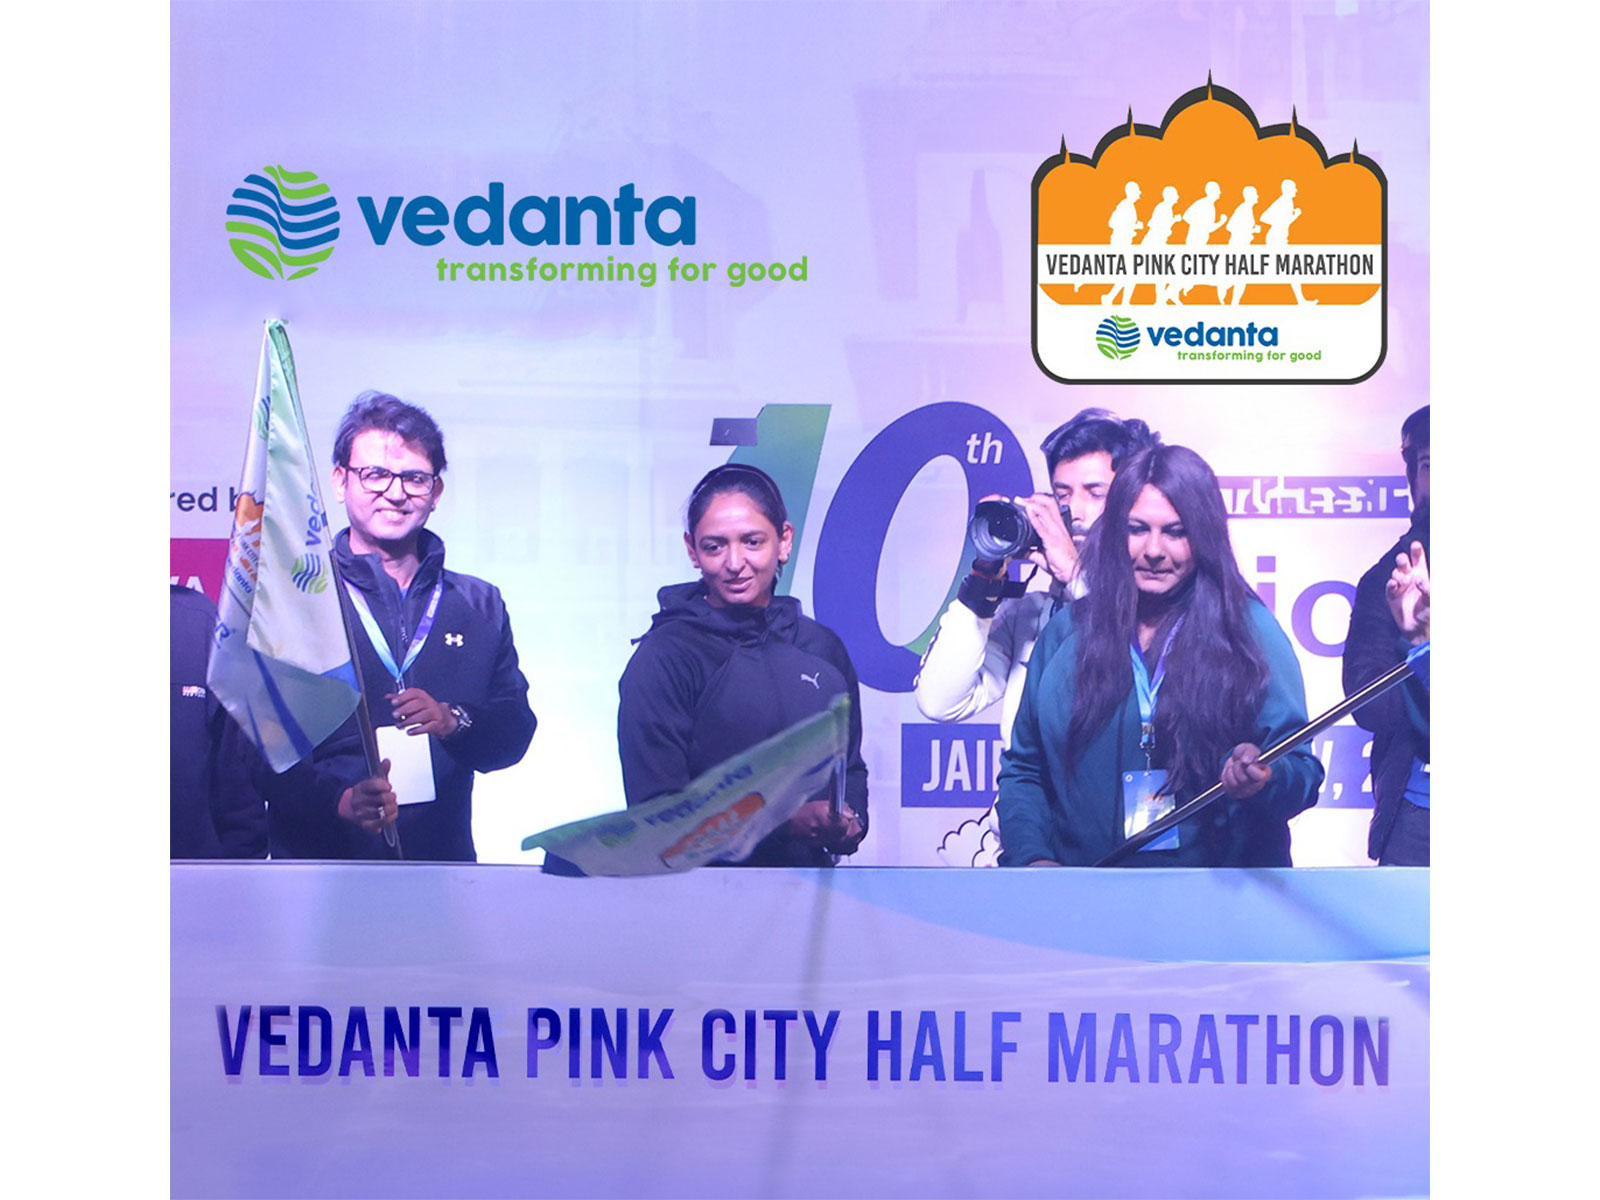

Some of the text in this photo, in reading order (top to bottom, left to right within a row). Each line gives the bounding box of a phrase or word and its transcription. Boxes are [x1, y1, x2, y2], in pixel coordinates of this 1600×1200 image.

[216, 1005, 1390, 1085] VEDANTA PINK CITY HALF MARATHON
